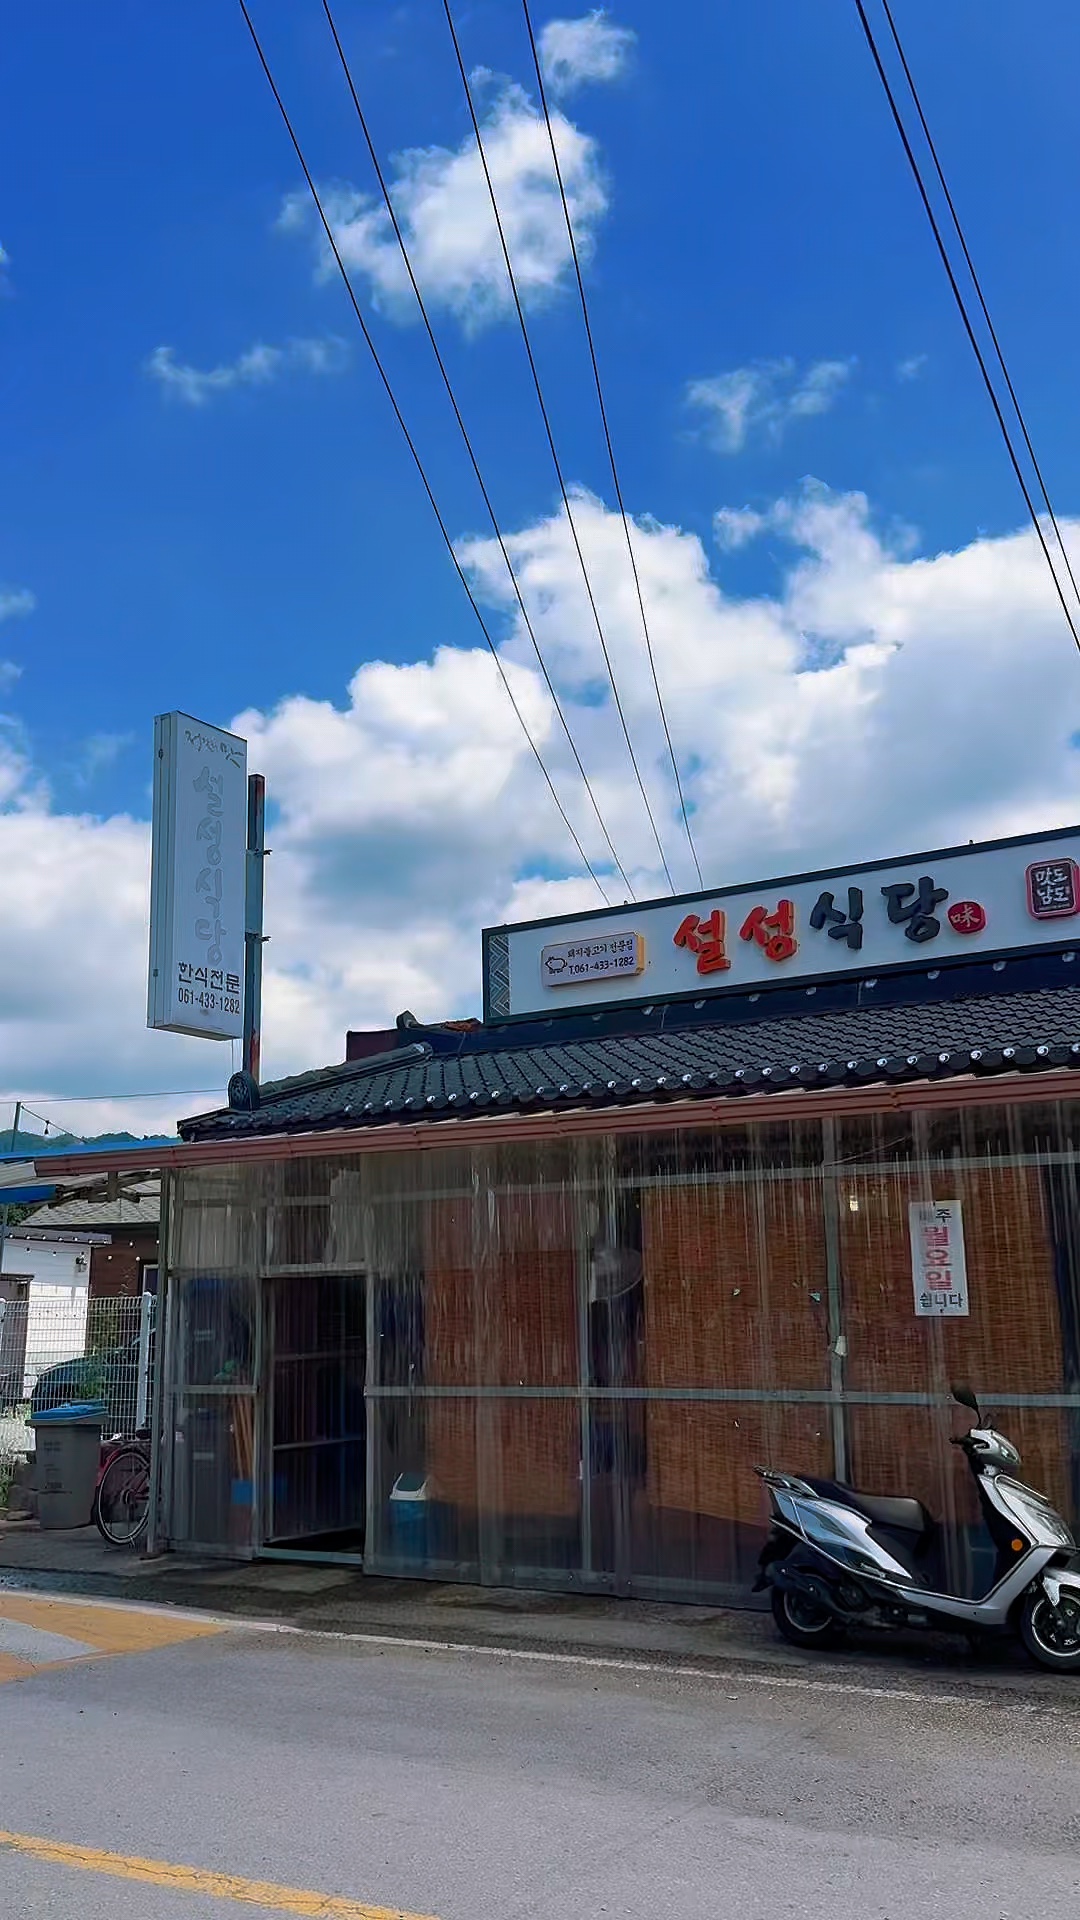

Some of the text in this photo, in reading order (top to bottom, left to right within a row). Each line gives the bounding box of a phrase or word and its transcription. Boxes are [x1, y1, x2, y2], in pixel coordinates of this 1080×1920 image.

[193, 765, 228, 968] 설성식당
[1036, 885, 1070, 906] 남도
[673, 875, 949, 975] 설성식당
[950, 907, 982, 933] 味
[610, 939, 633, 954] 전문점
[178, 961, 241, 995] 한식전문
[568, 956, 634, 975] T.061-433-1282
[178, 986, 241, 1015] 061-433-1282
[922, 1225, 953, 1292] 월요일
[919, 1291, 963, 1309] 쉽니다
